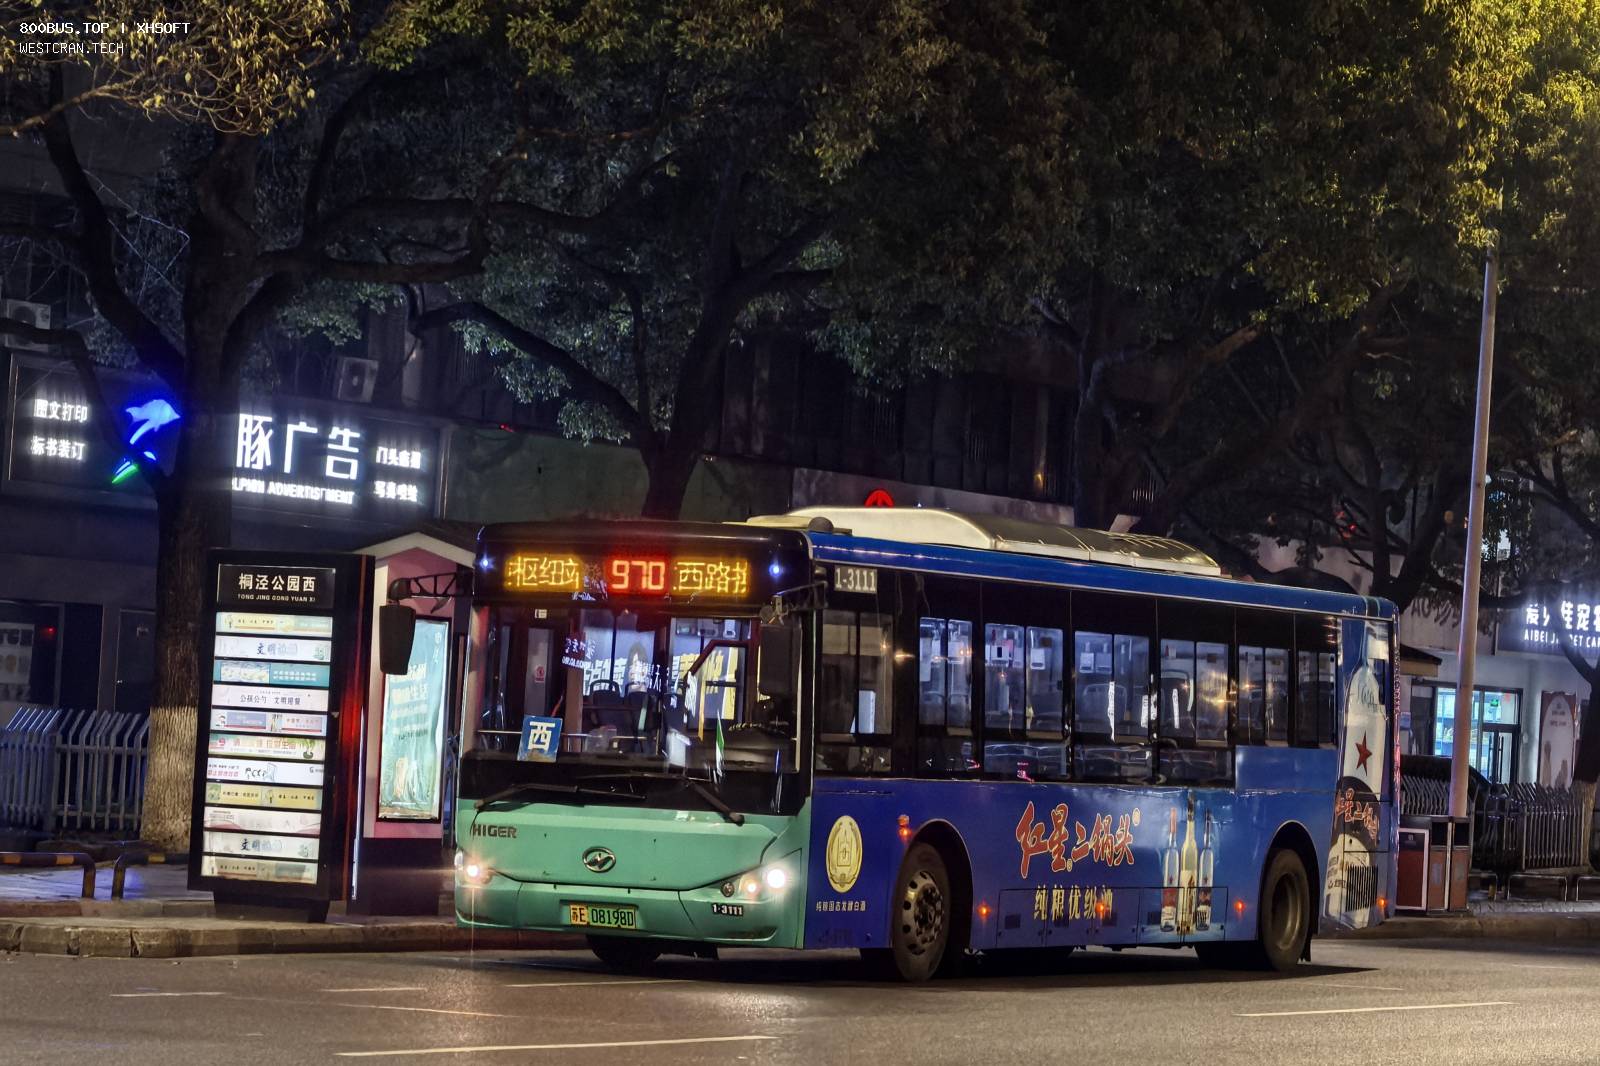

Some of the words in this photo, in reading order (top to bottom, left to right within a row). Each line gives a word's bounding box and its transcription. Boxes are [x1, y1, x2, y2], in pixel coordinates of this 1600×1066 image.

[34, 398, 88, 423] 图文打印
[31, 435, 86, 461] 标书装订
[236, 413, 361, 481] 豚广告
[238, 572, 316, 592] 桐泾公园西
[611, 559, 666, 591] 970
[835, 567, 876, 592] 1-3111
[527, 721, 555, 752] 西
[473, 823, 517, 839] HIGER
[1015, 800, 1135, 879] 红星二锅头
[711, 903, 743, 916] 1-3111
[1034, 885, 1113, 921] 纯粮优级酒
